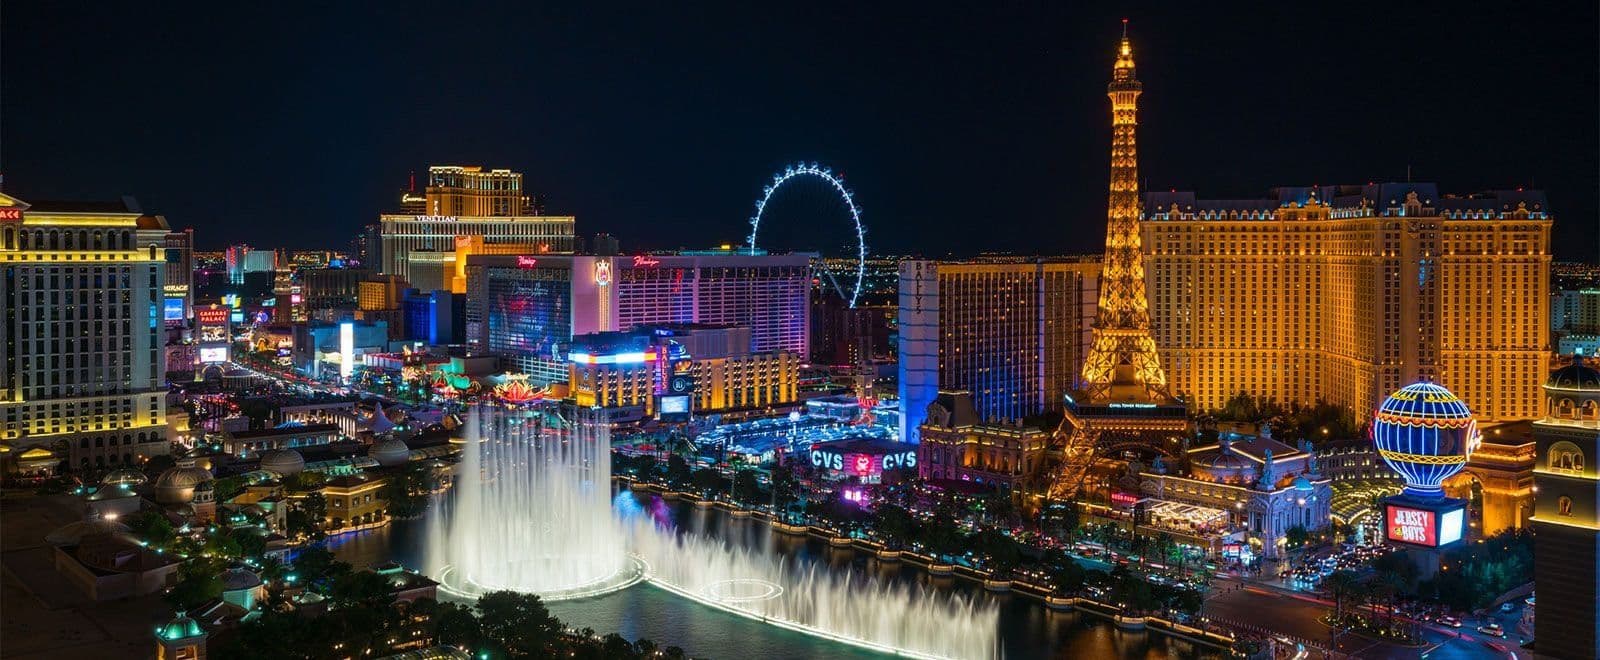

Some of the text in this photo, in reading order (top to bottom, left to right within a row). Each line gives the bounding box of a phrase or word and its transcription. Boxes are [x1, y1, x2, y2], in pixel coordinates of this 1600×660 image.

[633, 255, 659, 267] Flamingo
[811, 450, 843, 470] CVS
[882, 451, 917, 470] CVS
[1395, 510, 1427, 527] JERSEY
[1401, 526, 1425, 542] BOYS
